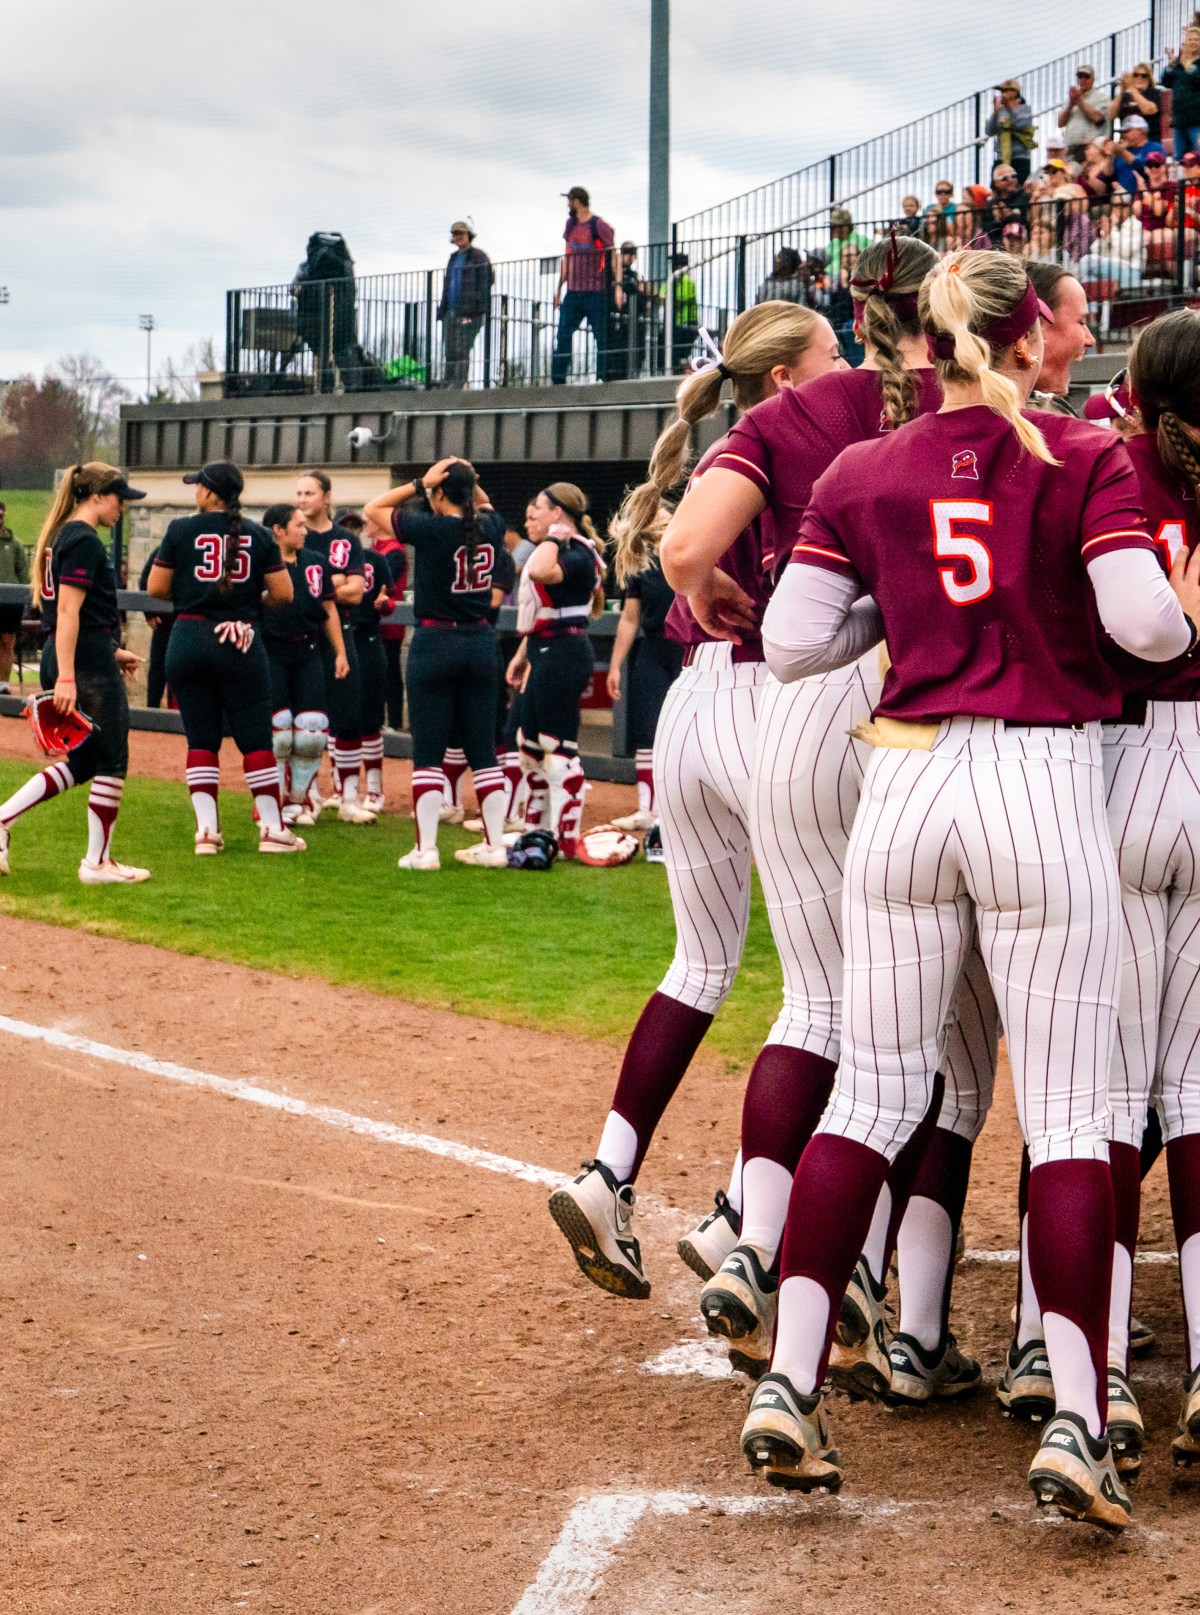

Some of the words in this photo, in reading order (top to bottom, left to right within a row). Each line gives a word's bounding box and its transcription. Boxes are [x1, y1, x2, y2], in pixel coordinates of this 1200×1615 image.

[195, 534, 252, 582] 35
[929, 498, 993, 606] 5
[452, 543, 496, 594] 12
[1031, 1360, 1050, 1371] NIK
[755, 1393, 780, 1405] NIKE
[1048, 1432, 1074, 1446] NIKE
